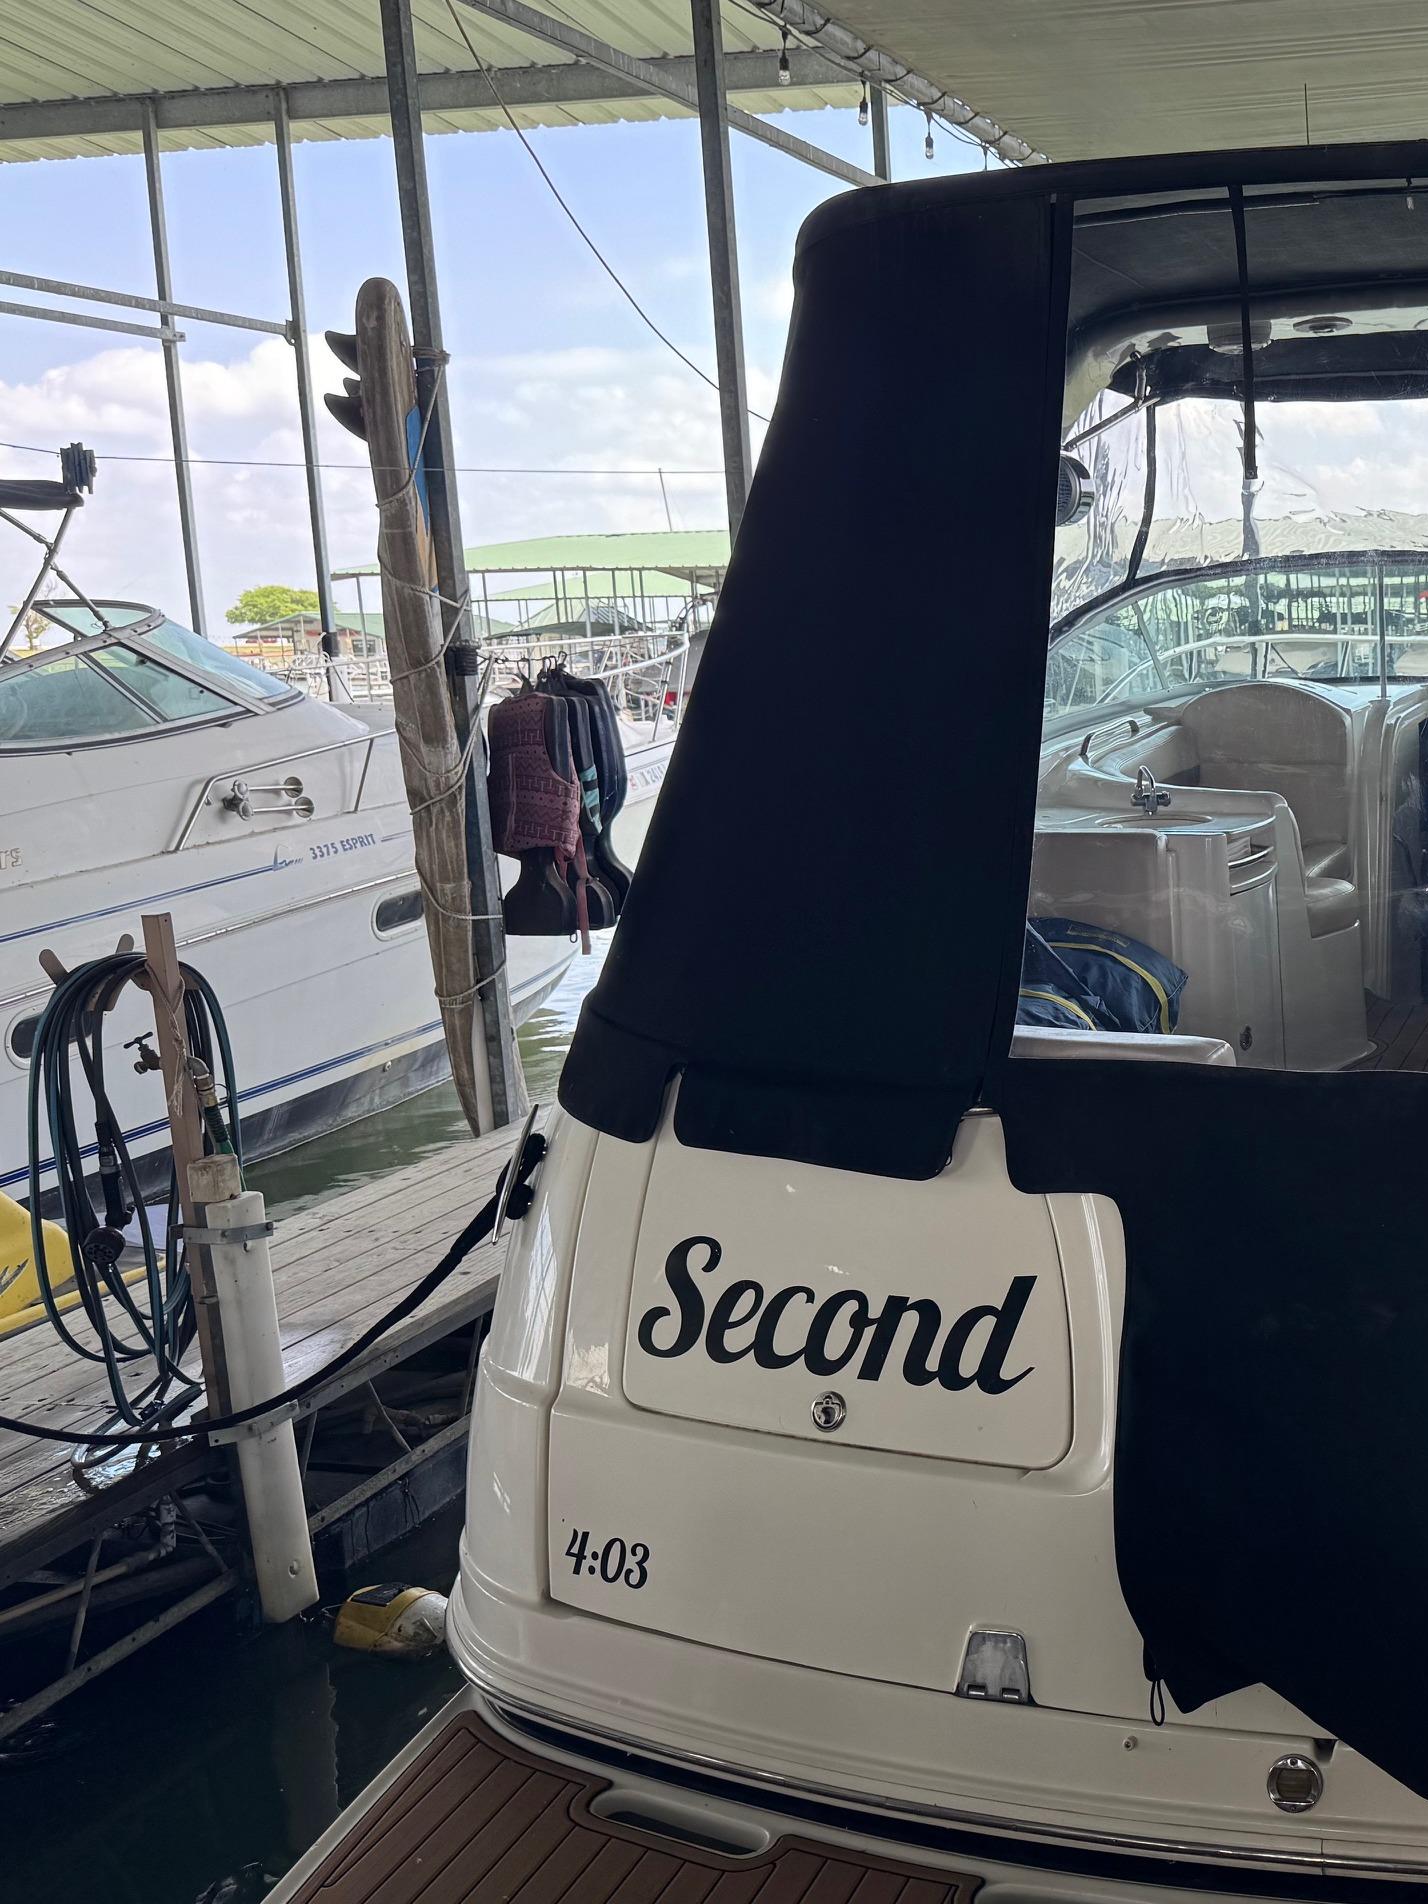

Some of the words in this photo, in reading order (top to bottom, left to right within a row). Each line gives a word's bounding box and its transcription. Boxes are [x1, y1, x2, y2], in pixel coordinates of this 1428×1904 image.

[309, 842, 339, 860] 3375
[339, 833, 376, 852] ESPRIT
[638, 1235, 1038, 1395] Second
[565, 1528, 650, 1589] 4:03
